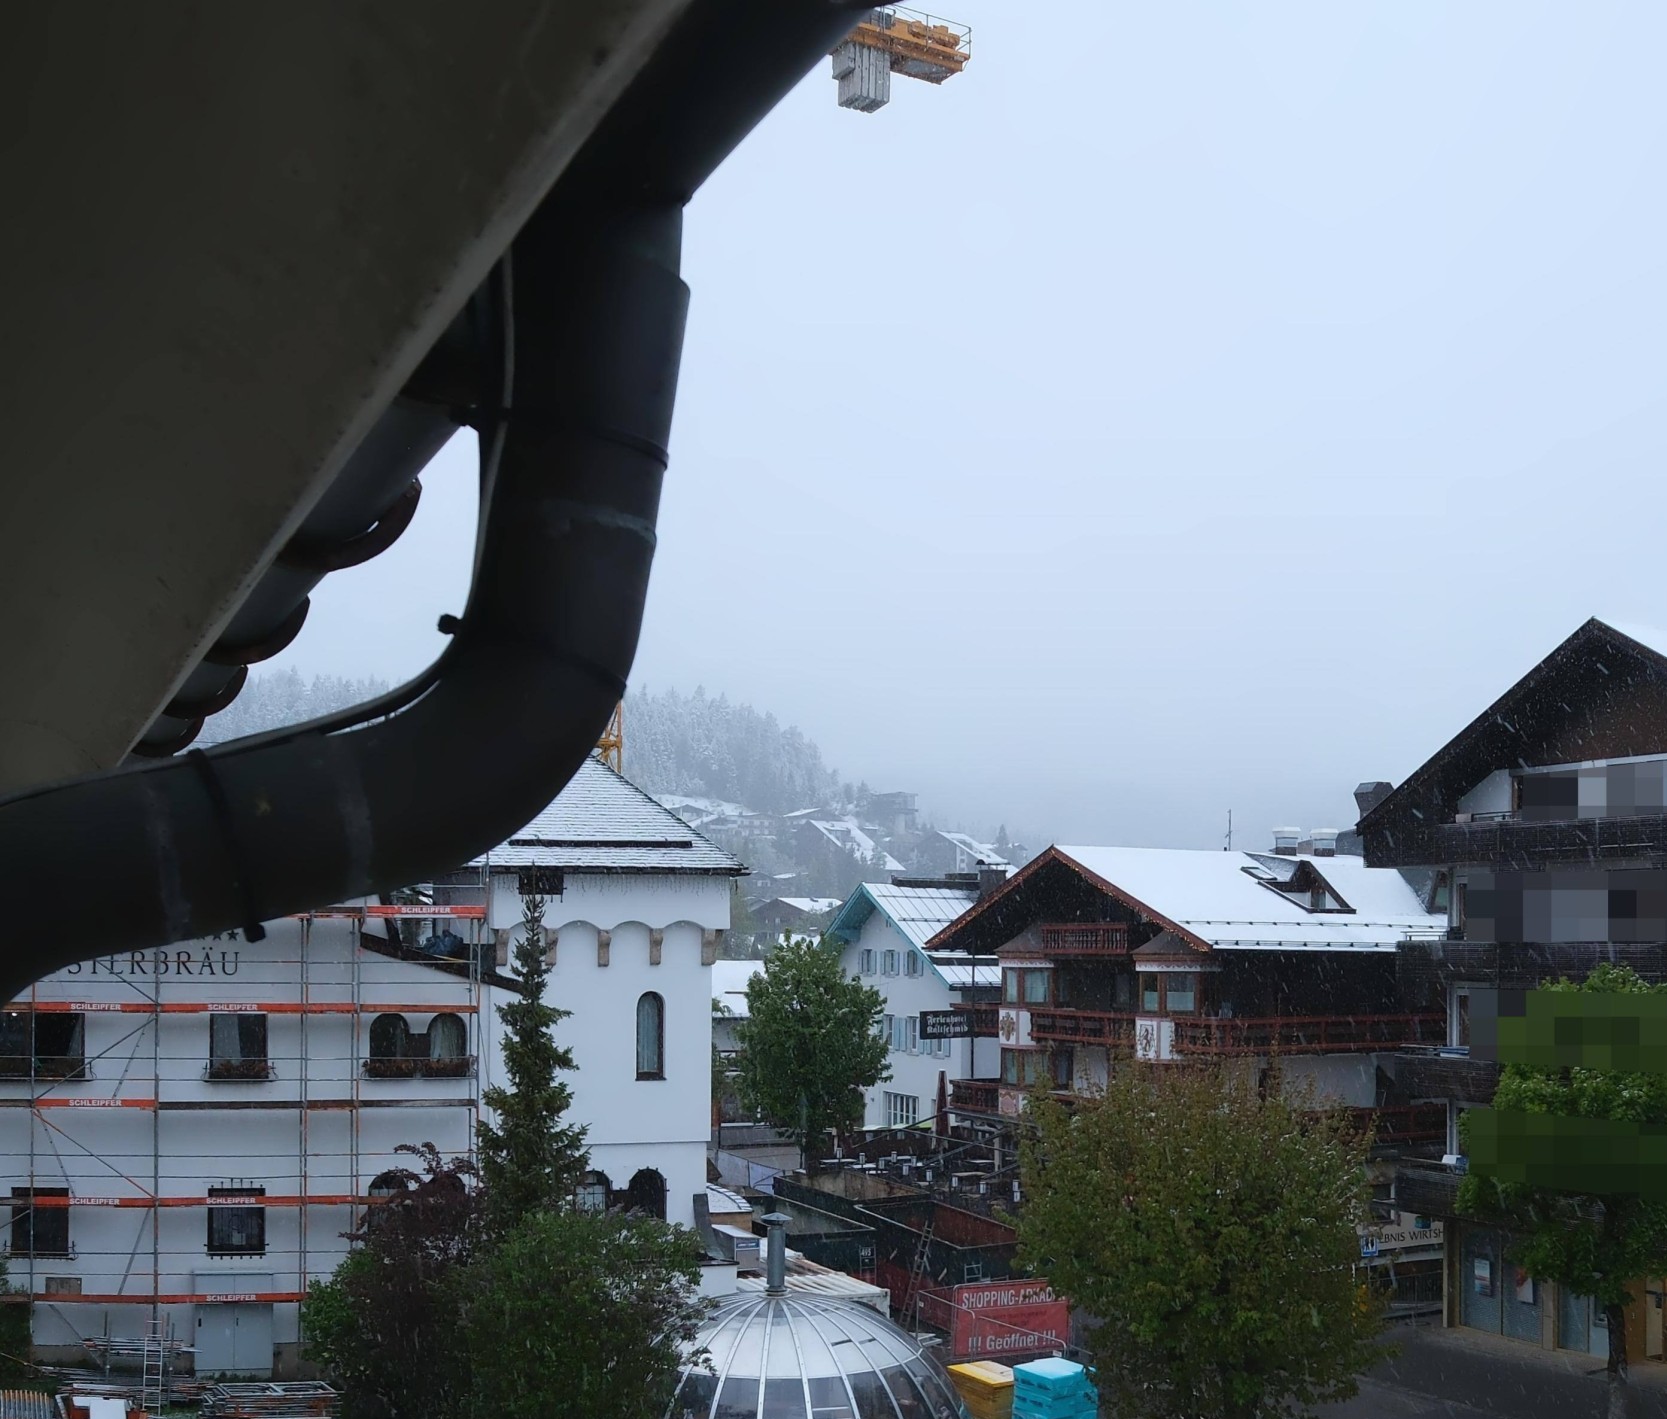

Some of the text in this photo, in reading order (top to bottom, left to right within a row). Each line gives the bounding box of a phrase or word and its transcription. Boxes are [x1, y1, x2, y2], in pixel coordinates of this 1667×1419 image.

[401, 906, 451, 914] SCHLEIPFER
[70, 1003, 121, 1011] SCHLEIPFER
[207, 1003, 258, 1011] SCHLEIPFER
[206, 1197, 256, 1205] SCHLEIPFER
[986, 1332, 1039, 1350] Geöffnet
